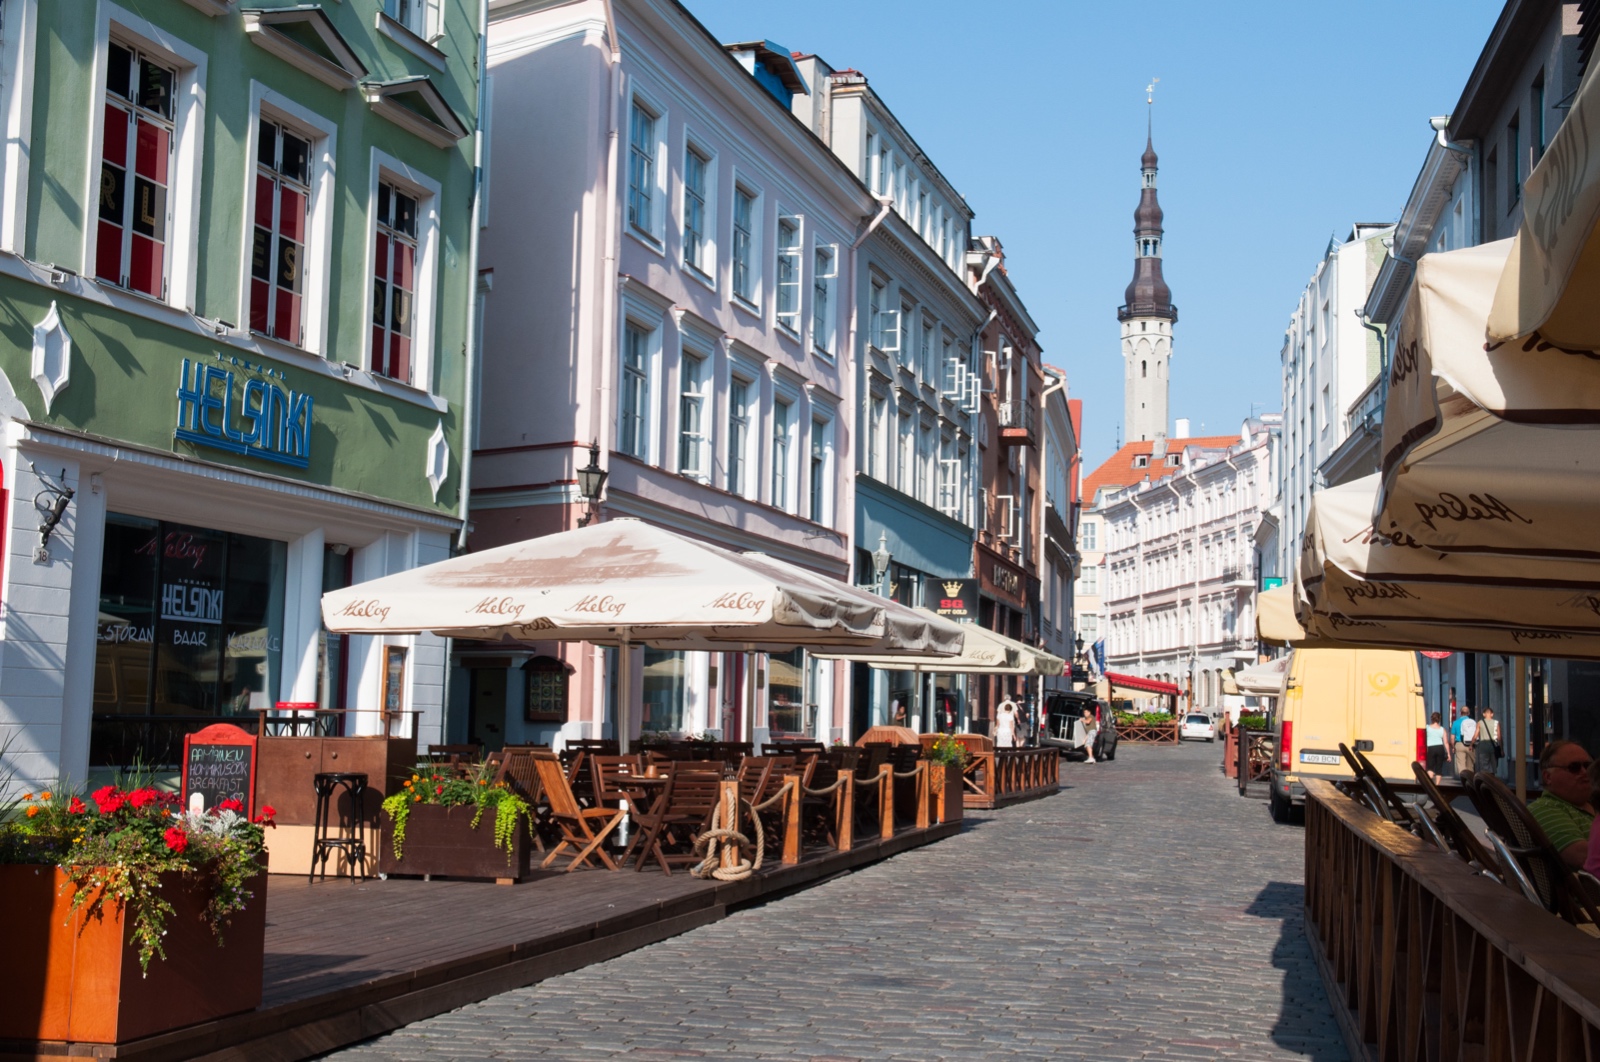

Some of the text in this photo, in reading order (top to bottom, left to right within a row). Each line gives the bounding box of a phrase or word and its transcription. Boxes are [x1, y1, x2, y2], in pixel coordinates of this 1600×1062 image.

[176, 357, 314, 459] HELSINKI
[39, 550, 48, 562] 18
[162, 583, 224, 621] HELSINKI
[173, 629, 208, 647] BAAR
[227, 631, 281, 652] KARAOKE
[189, 776, 243, 792] BREAKFAST
